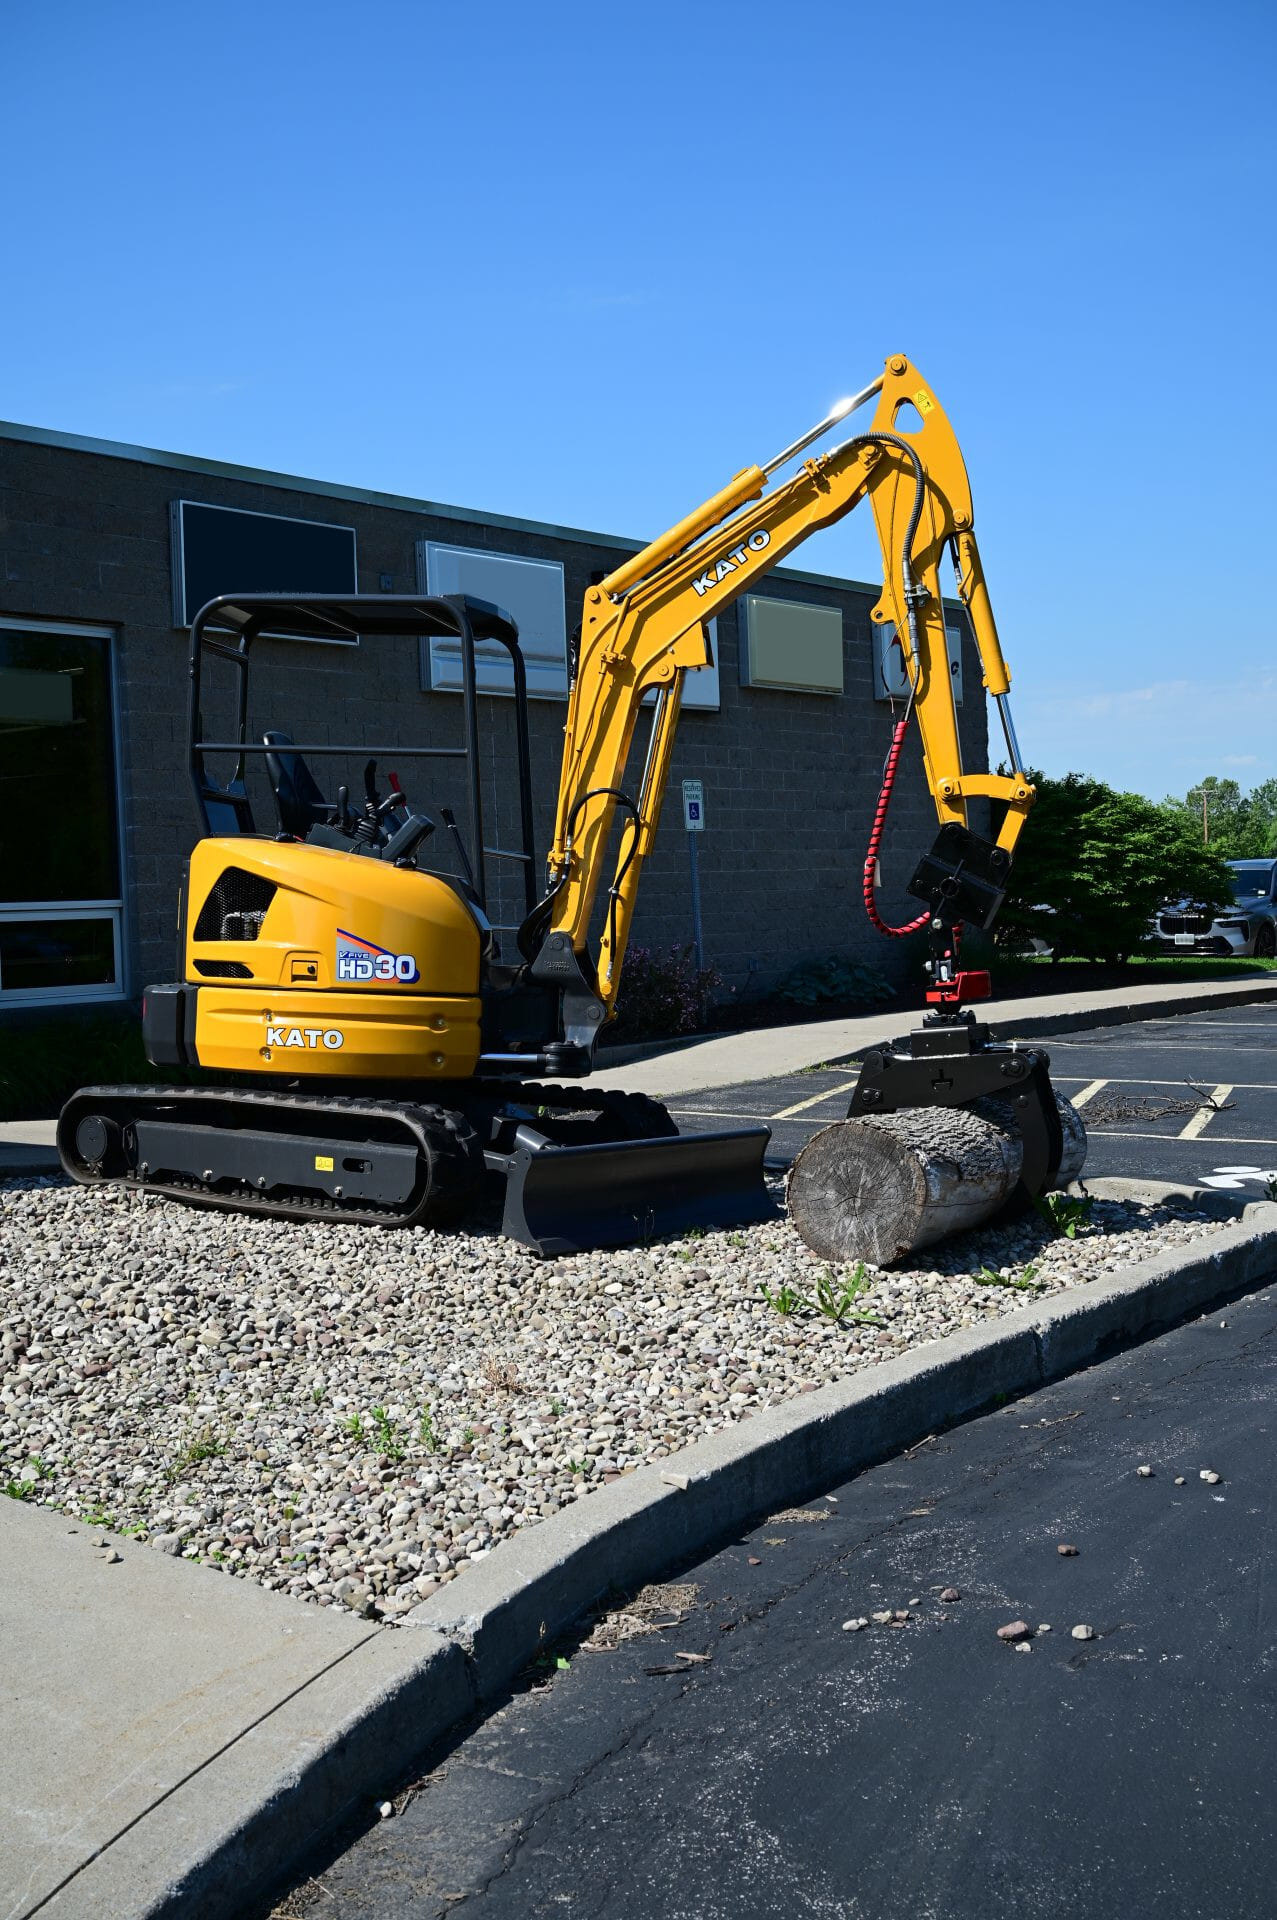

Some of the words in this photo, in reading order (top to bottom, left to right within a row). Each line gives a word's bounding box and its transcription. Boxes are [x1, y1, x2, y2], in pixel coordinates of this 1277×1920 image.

[691, 529, 770, 597] KATO
[339, 954, 416, 980] HD30
[266, 1027, 344, 1049] KATO
